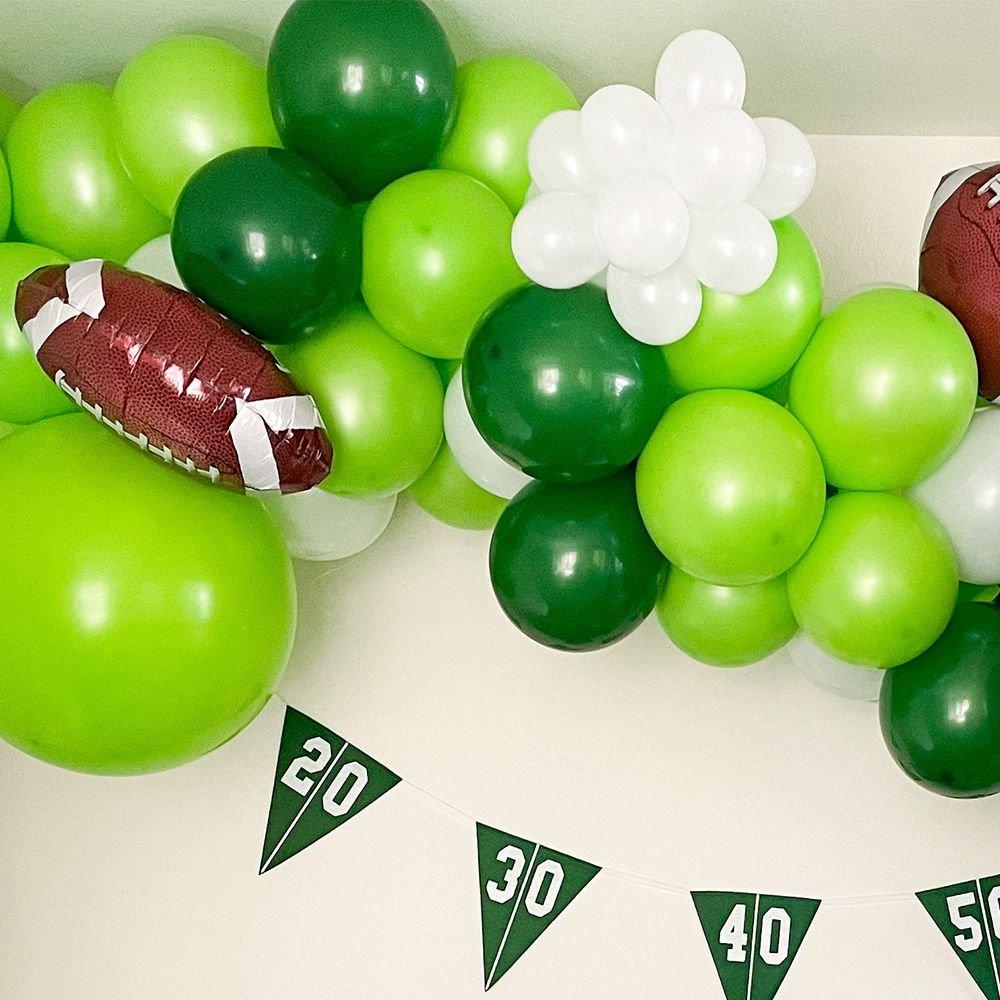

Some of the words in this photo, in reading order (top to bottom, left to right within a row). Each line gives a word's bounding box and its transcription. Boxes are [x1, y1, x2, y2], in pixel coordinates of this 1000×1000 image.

[281, 736, 369, 817] 20
[486, 844, 565, 918] 30
[719, 903, 792, 966] 40
